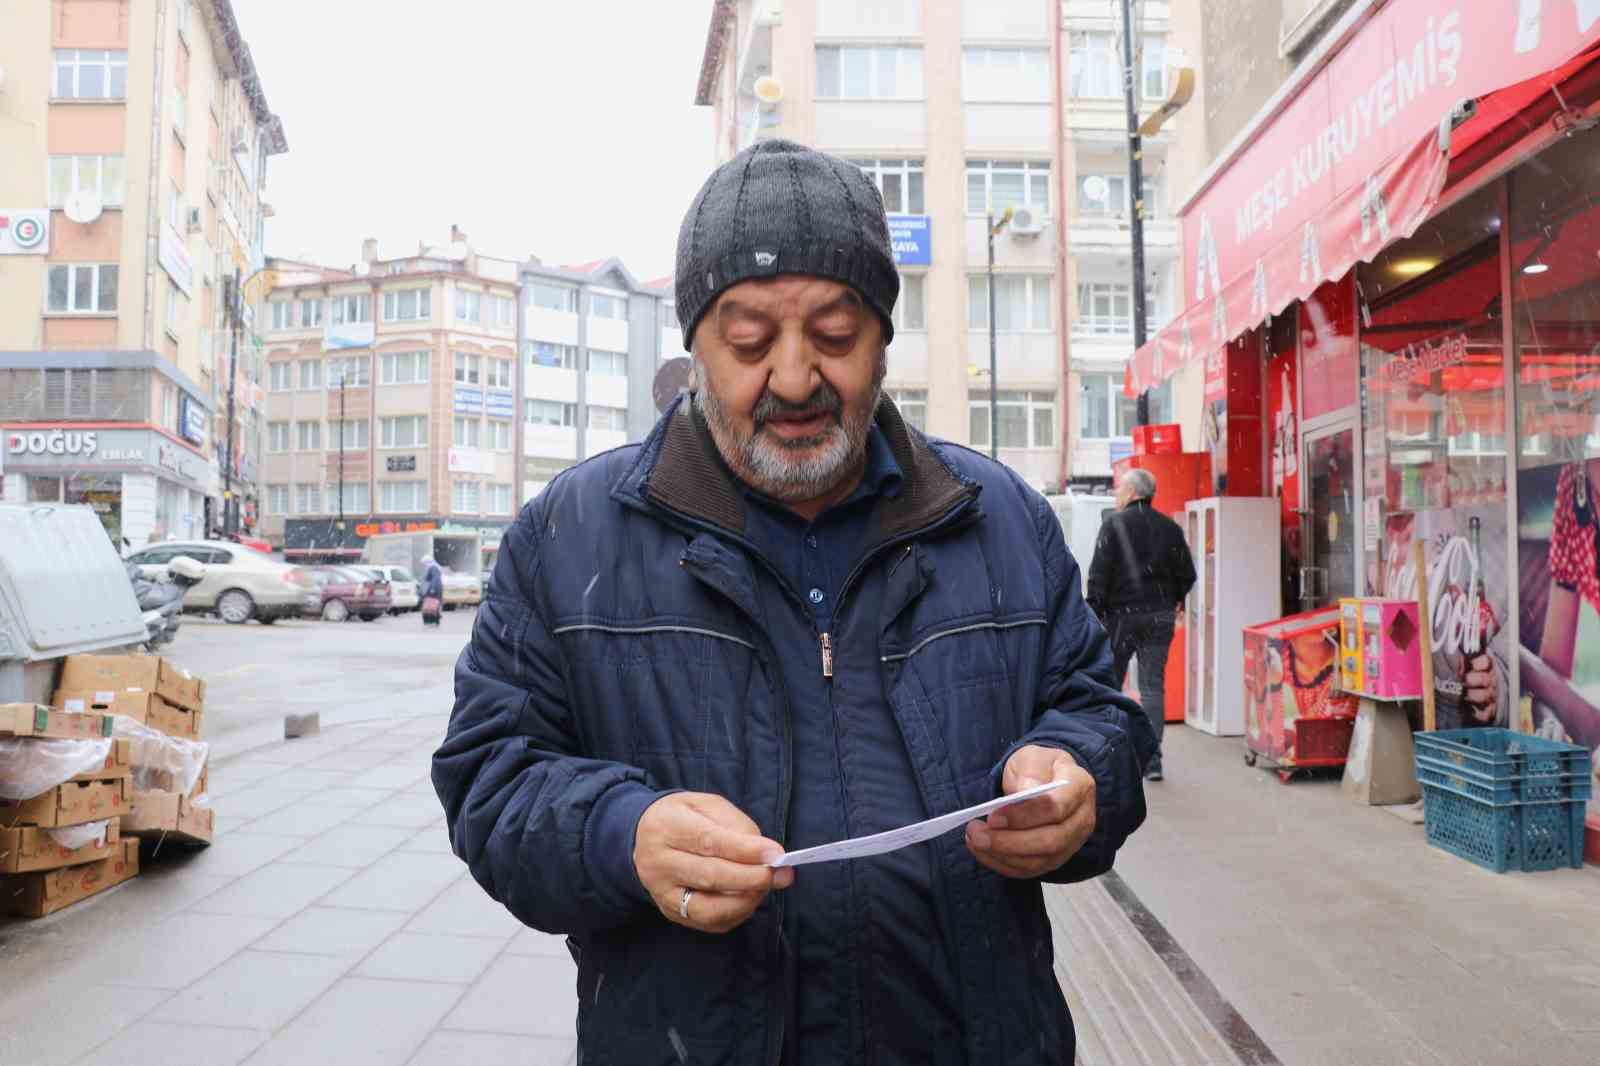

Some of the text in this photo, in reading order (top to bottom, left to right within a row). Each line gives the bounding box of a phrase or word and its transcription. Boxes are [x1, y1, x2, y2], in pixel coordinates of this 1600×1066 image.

[1235, 10, 1462, 244] MEŞE KURUYEMİŞ
[8, 428, 97, 457] DOĞUŞ
